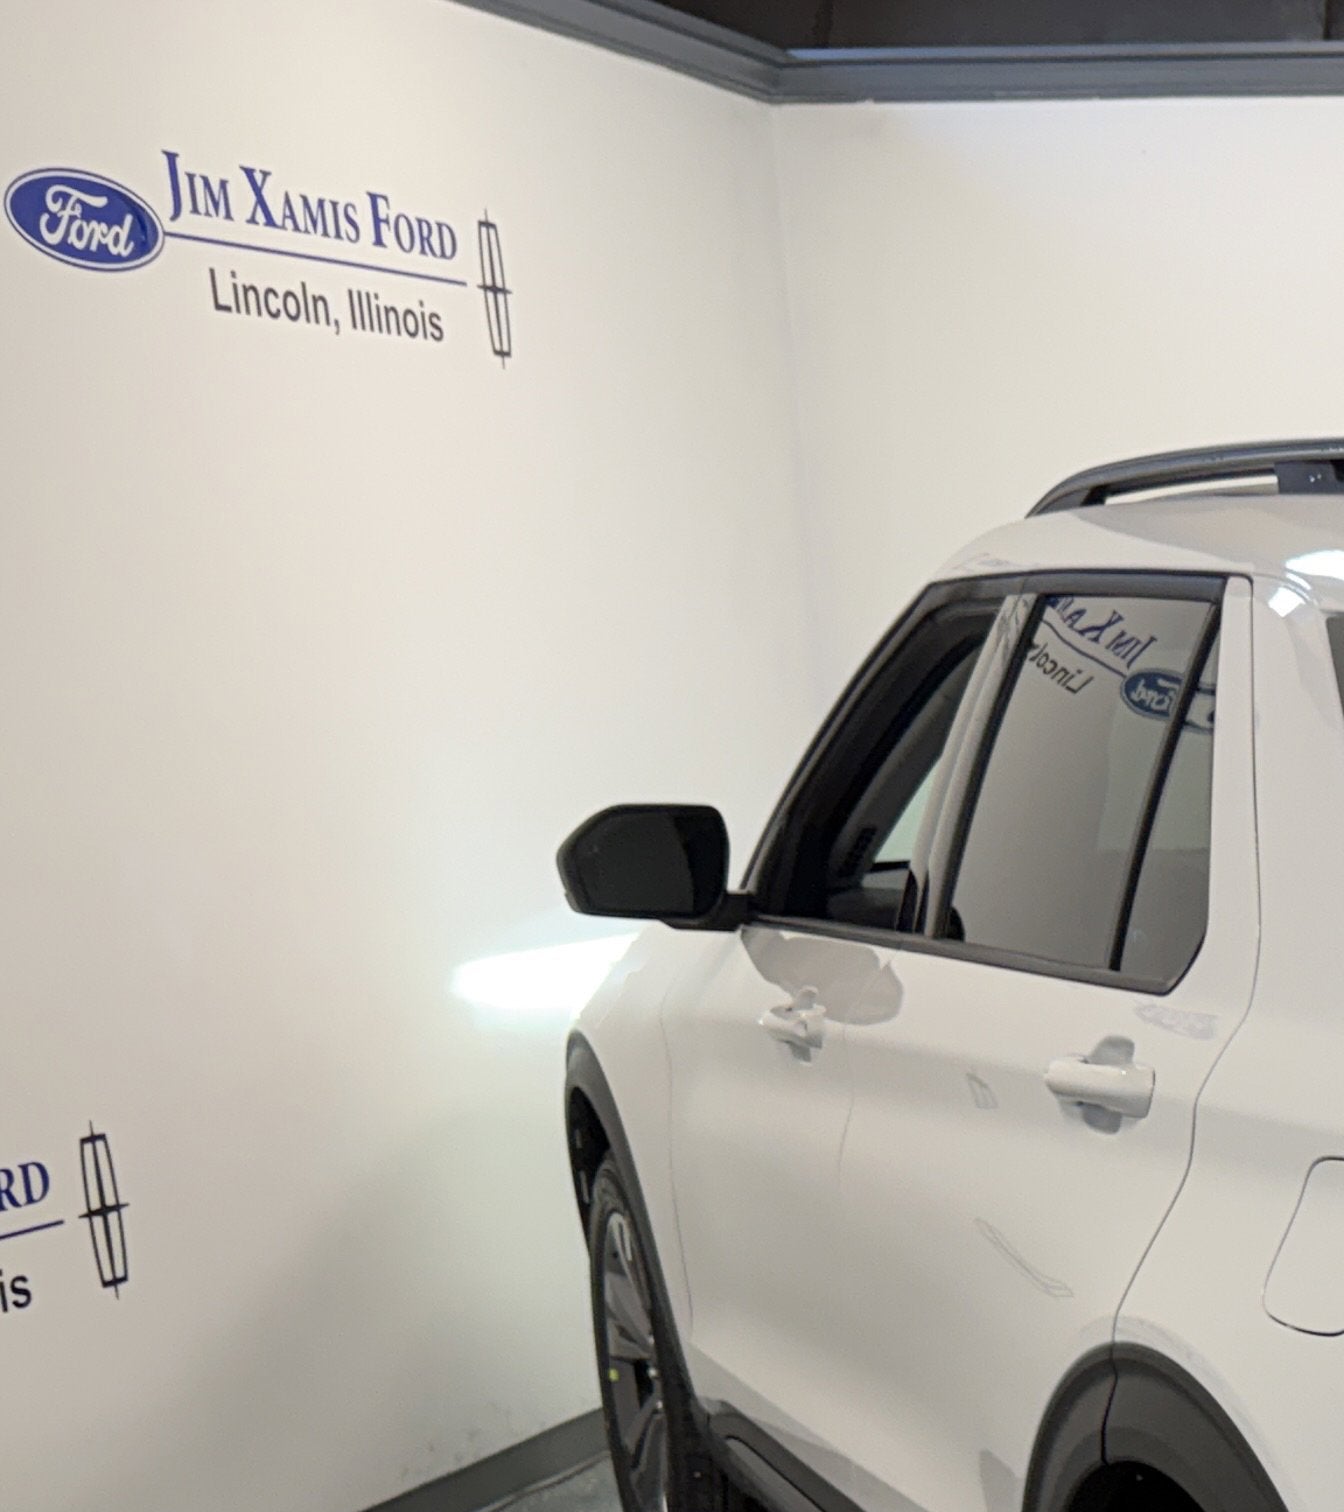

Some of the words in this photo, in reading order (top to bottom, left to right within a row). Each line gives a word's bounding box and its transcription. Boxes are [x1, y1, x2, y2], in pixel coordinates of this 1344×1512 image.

[40, 184, 134, 258] Ford
[161, 149, 235, 222] JIM
[240, 165, 361, 243] XAMIS
[366, 191, 457, 260] FORD
[209, 267, 340, 334] Lincoln,
[348, 289, 444, 341] Illinois
[0, 1161, 50, 1212] RD
